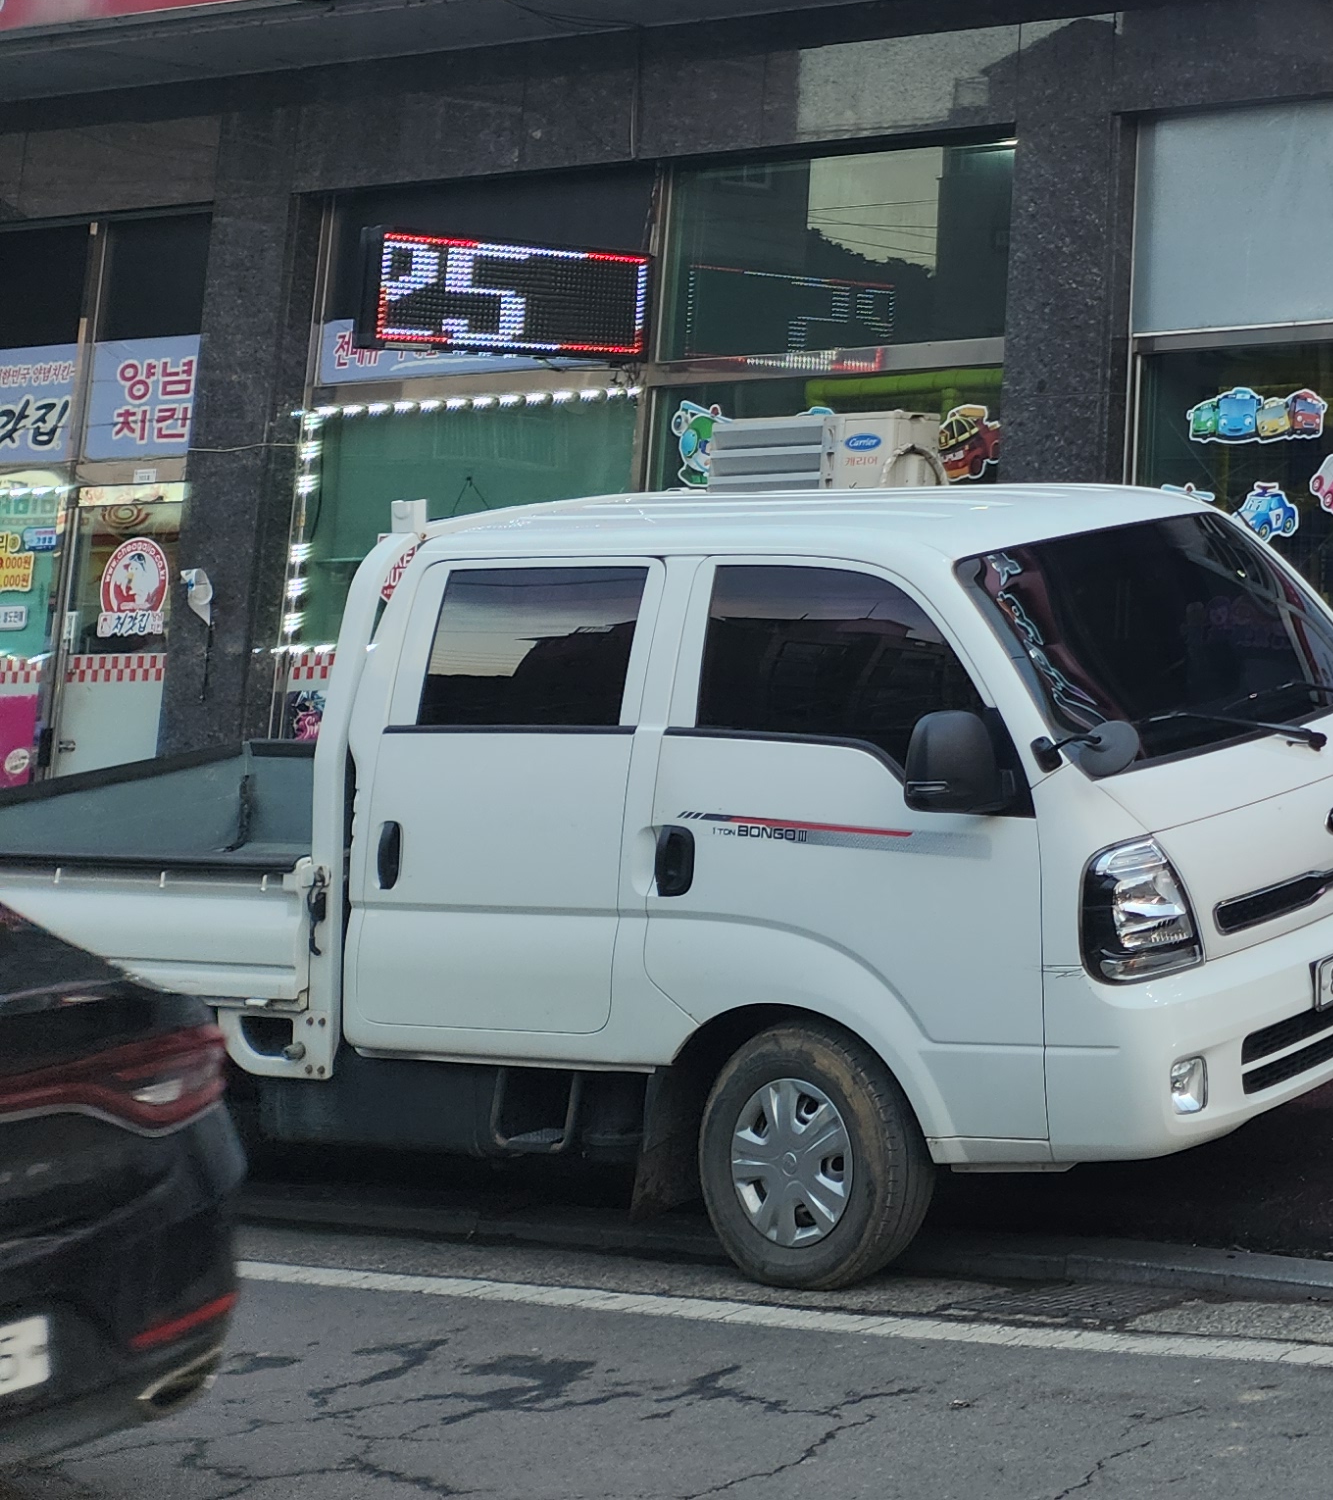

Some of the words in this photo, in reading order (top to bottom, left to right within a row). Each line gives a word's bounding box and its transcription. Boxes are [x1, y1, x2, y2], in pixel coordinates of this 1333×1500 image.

[118, 358, 194, 401] 양념
[113, 404, 190, 444] 치킨
[849, 437, 879, 447] Carrier
[845, 456, 878, 466] 캐리어
[717, 828, 736, 836] TON
[737, 825, 796, 841] BONGO
